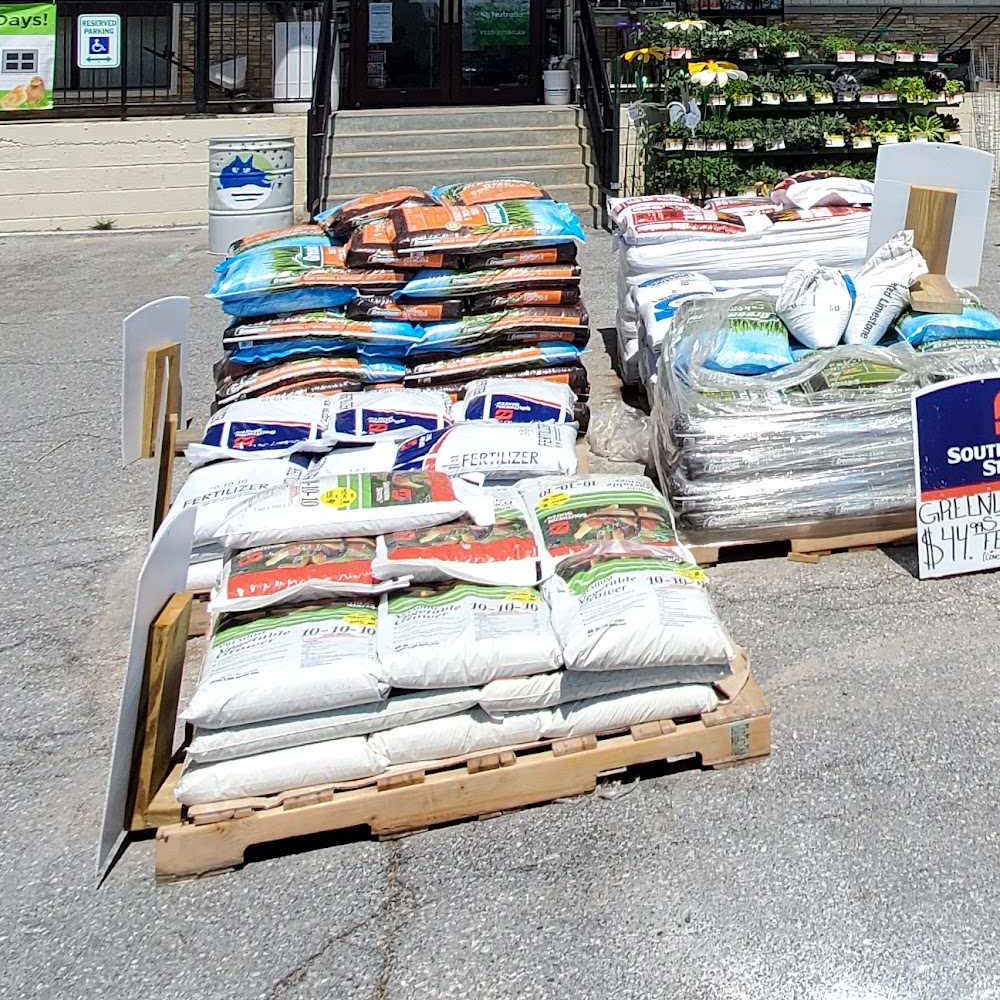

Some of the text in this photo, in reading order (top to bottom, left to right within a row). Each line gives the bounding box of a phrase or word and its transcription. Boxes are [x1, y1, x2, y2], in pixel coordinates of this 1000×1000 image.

[82, 19, 117, 27] RESERVED
[860, 297, 890, 339] Limestone
[461, 451, 540, 467] FERTILIZER
[182, 483, 269, 509] FERTILIZER
[470, 601, 539, 612] 10-10-10
[301, 625, 376, 637] 10-10-10
